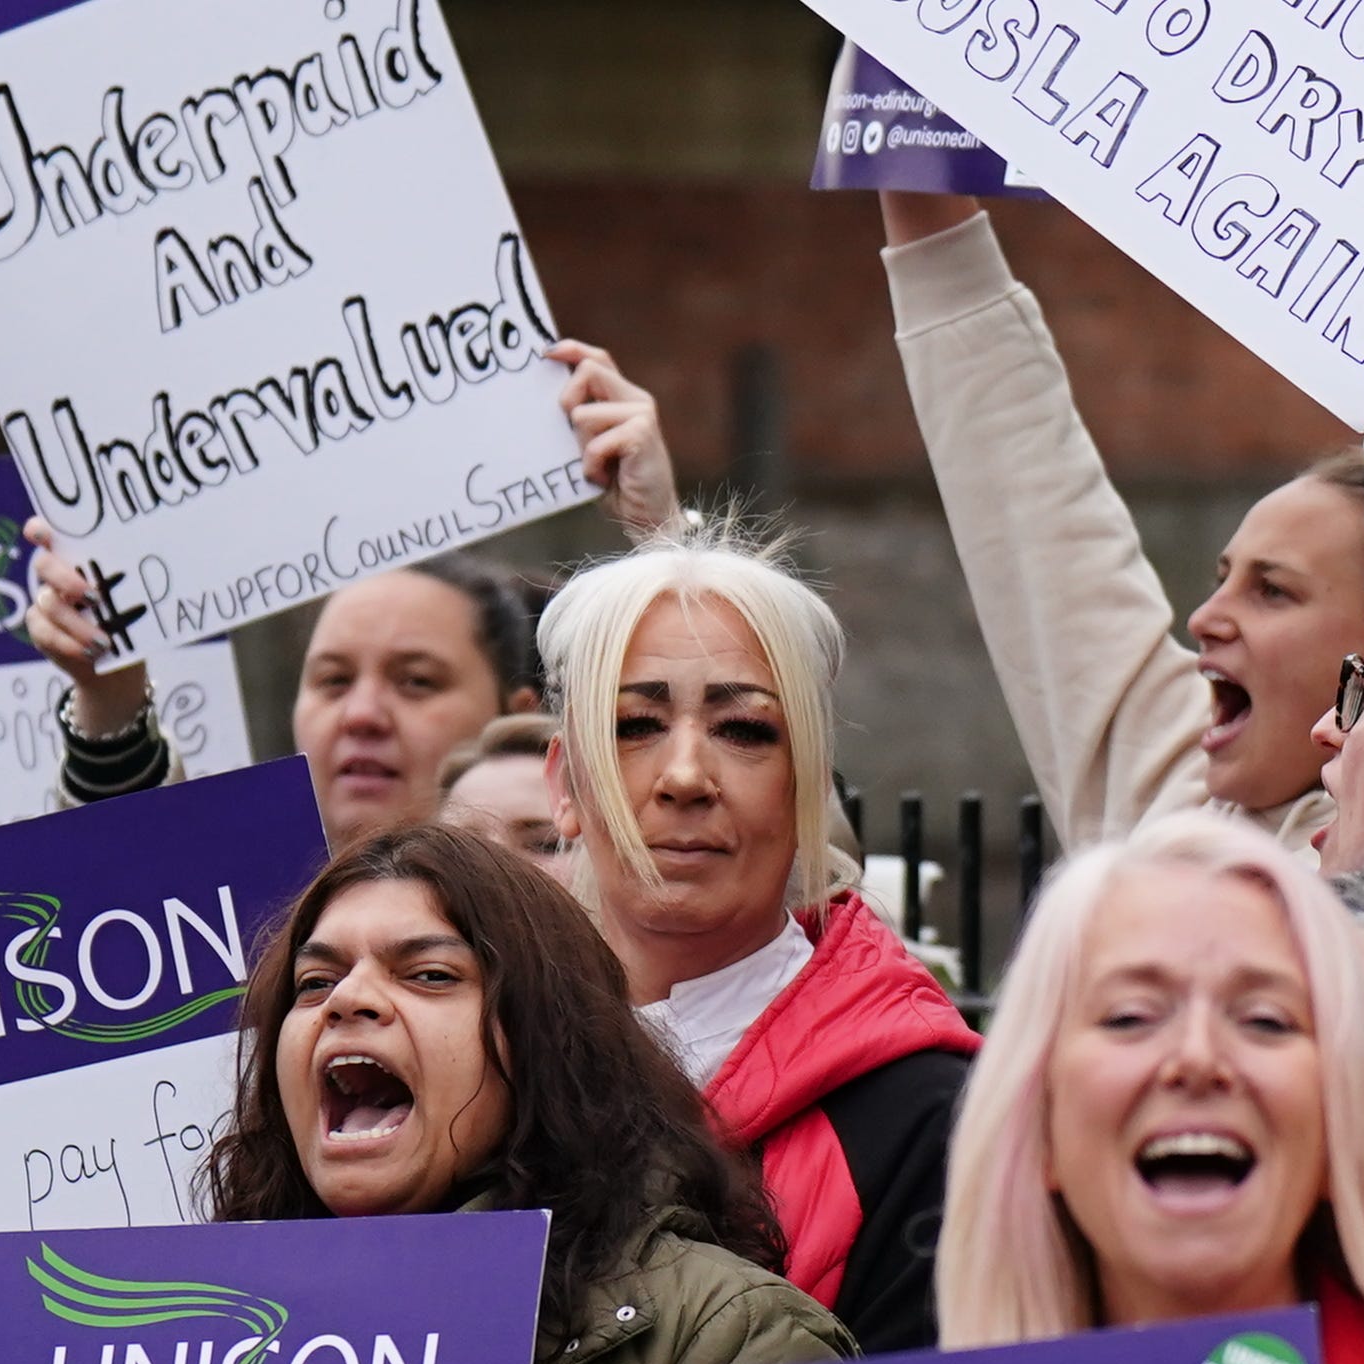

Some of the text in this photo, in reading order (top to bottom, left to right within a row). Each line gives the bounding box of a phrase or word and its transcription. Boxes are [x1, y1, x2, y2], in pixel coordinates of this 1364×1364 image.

[894, 0, 1149, 168] OSLA
[1093, 0, 1211, 56] O
[153, 175, 315, 334] And
[23, 1138, 132, 1232] pay
